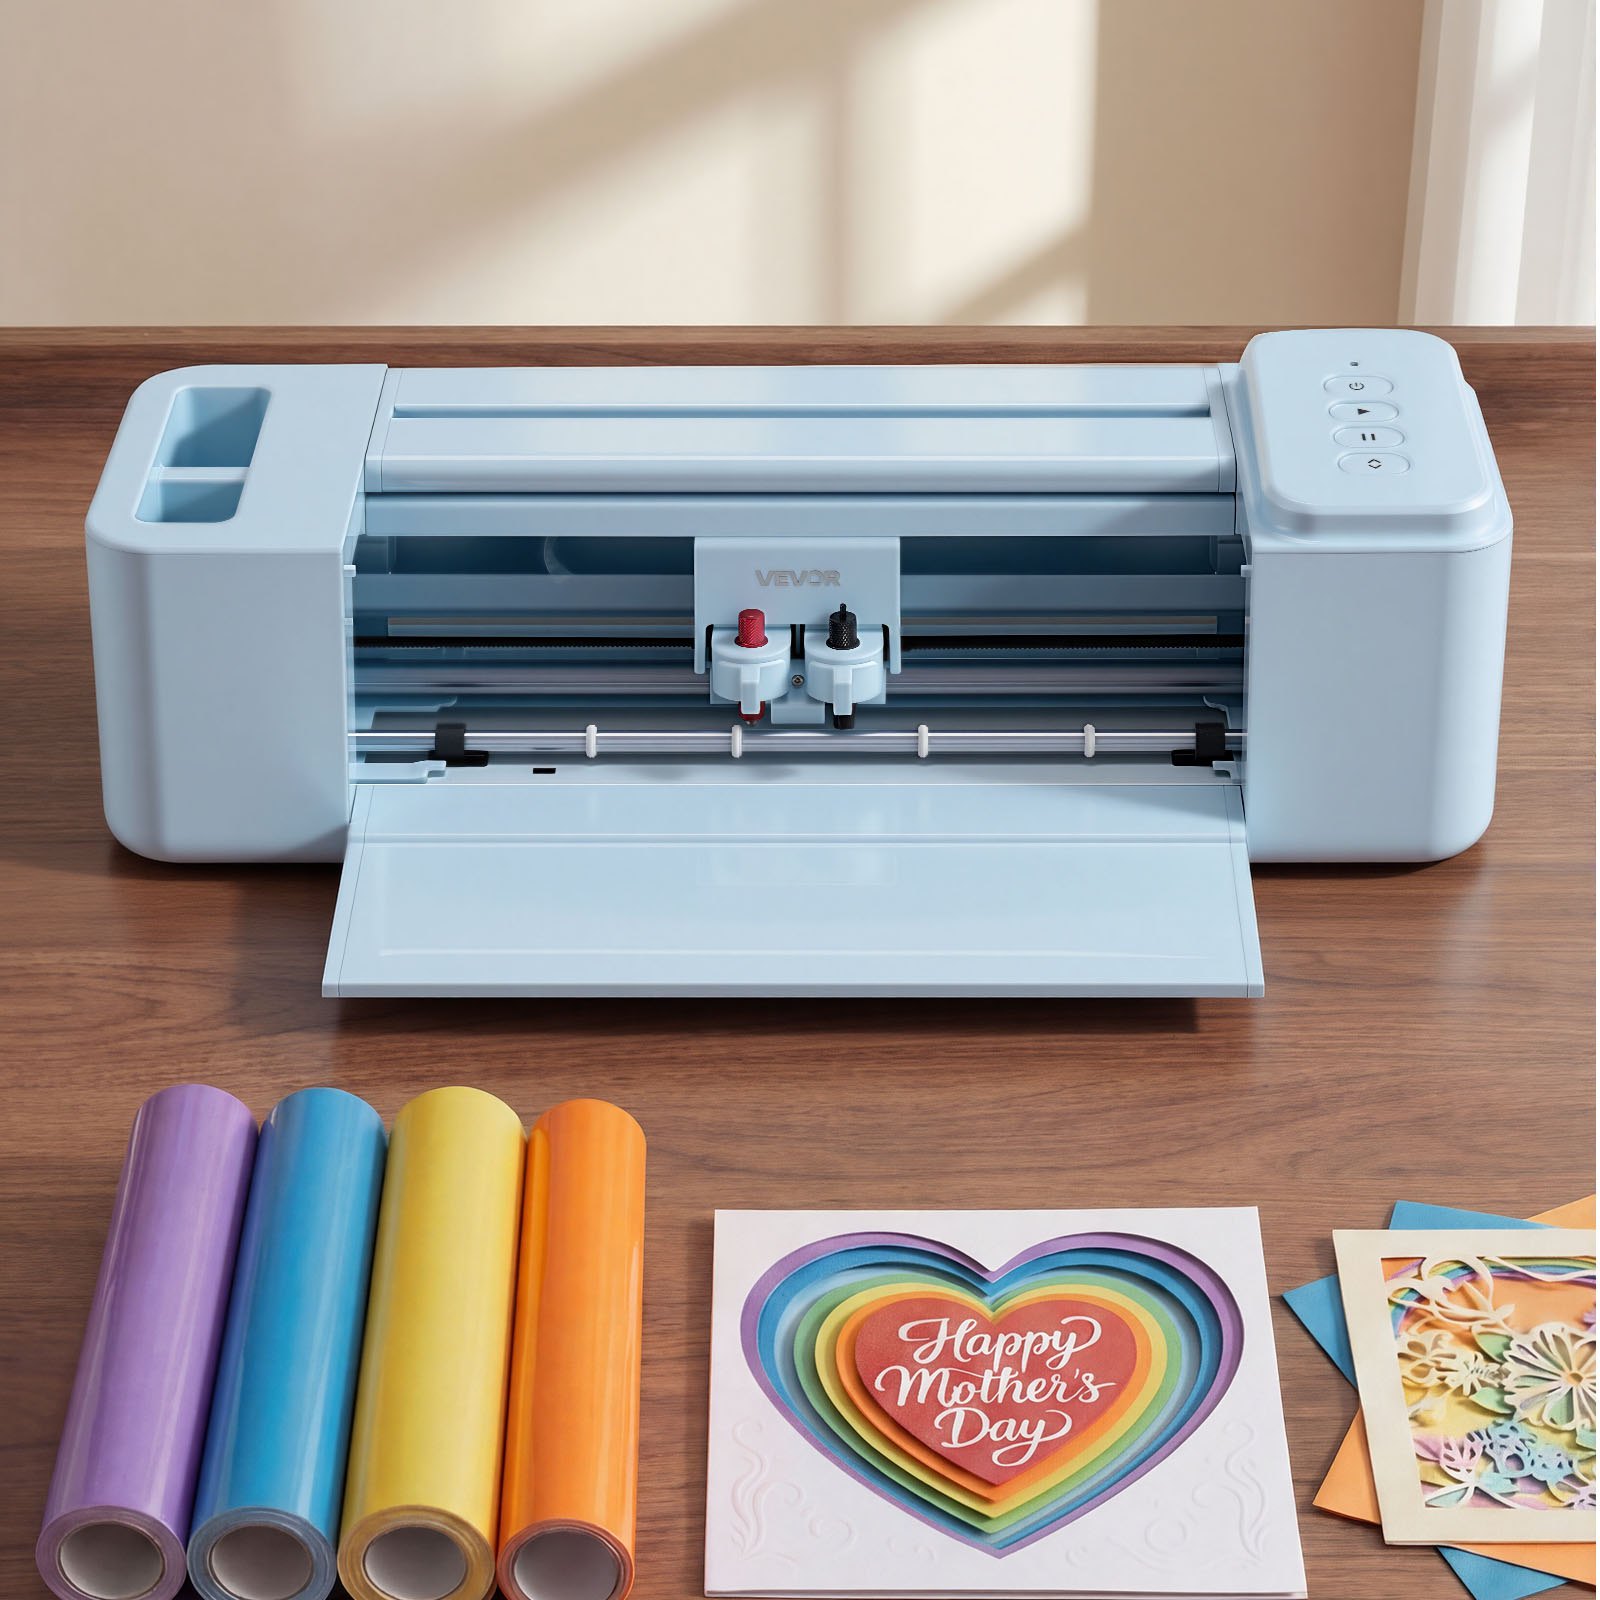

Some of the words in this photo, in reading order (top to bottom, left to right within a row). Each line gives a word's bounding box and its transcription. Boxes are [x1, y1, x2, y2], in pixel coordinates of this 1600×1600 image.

[755, 569, 842, 587] VEVOR
[898, 1315, 1102, 1373] Happy
[874, 1365, 1117, 1407] Mother's
[934, 1406, 1073, 1467] Day
